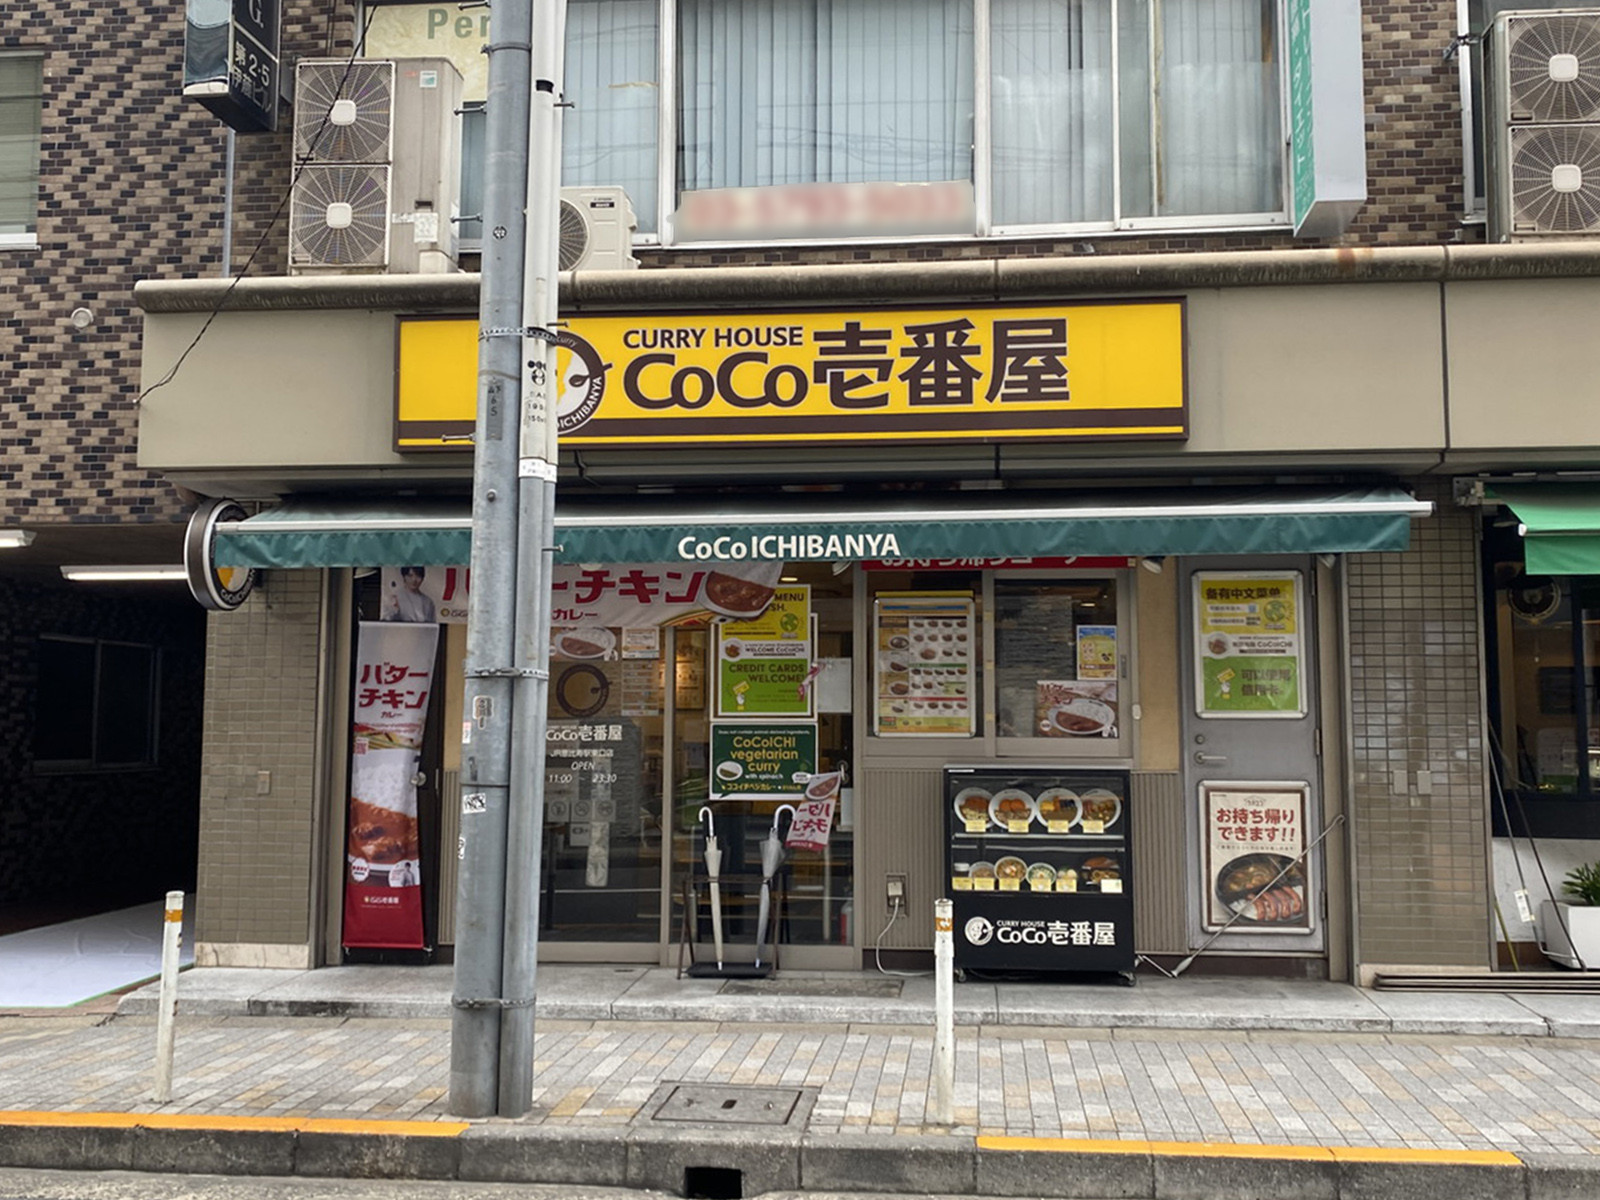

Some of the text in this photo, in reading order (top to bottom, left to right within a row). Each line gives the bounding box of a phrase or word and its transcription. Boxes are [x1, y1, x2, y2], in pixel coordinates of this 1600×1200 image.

[622, 326, 804, 350] CURRY HOUSE
[775, 592, 805, 602] MENU
[552, 608, 598, 620] カレー
[360, 661, 428, 685] バター
[728, 664, 805, 673] CREDIT CARDS
[358, 688, 428, 710] チキン
[730, 749, 799, 762] vegetarian
[571, 761, 595, 771] OPEN
[748, 762, 781, 774] curry
[1216, 807, 1295, 825] お持ち帰り
